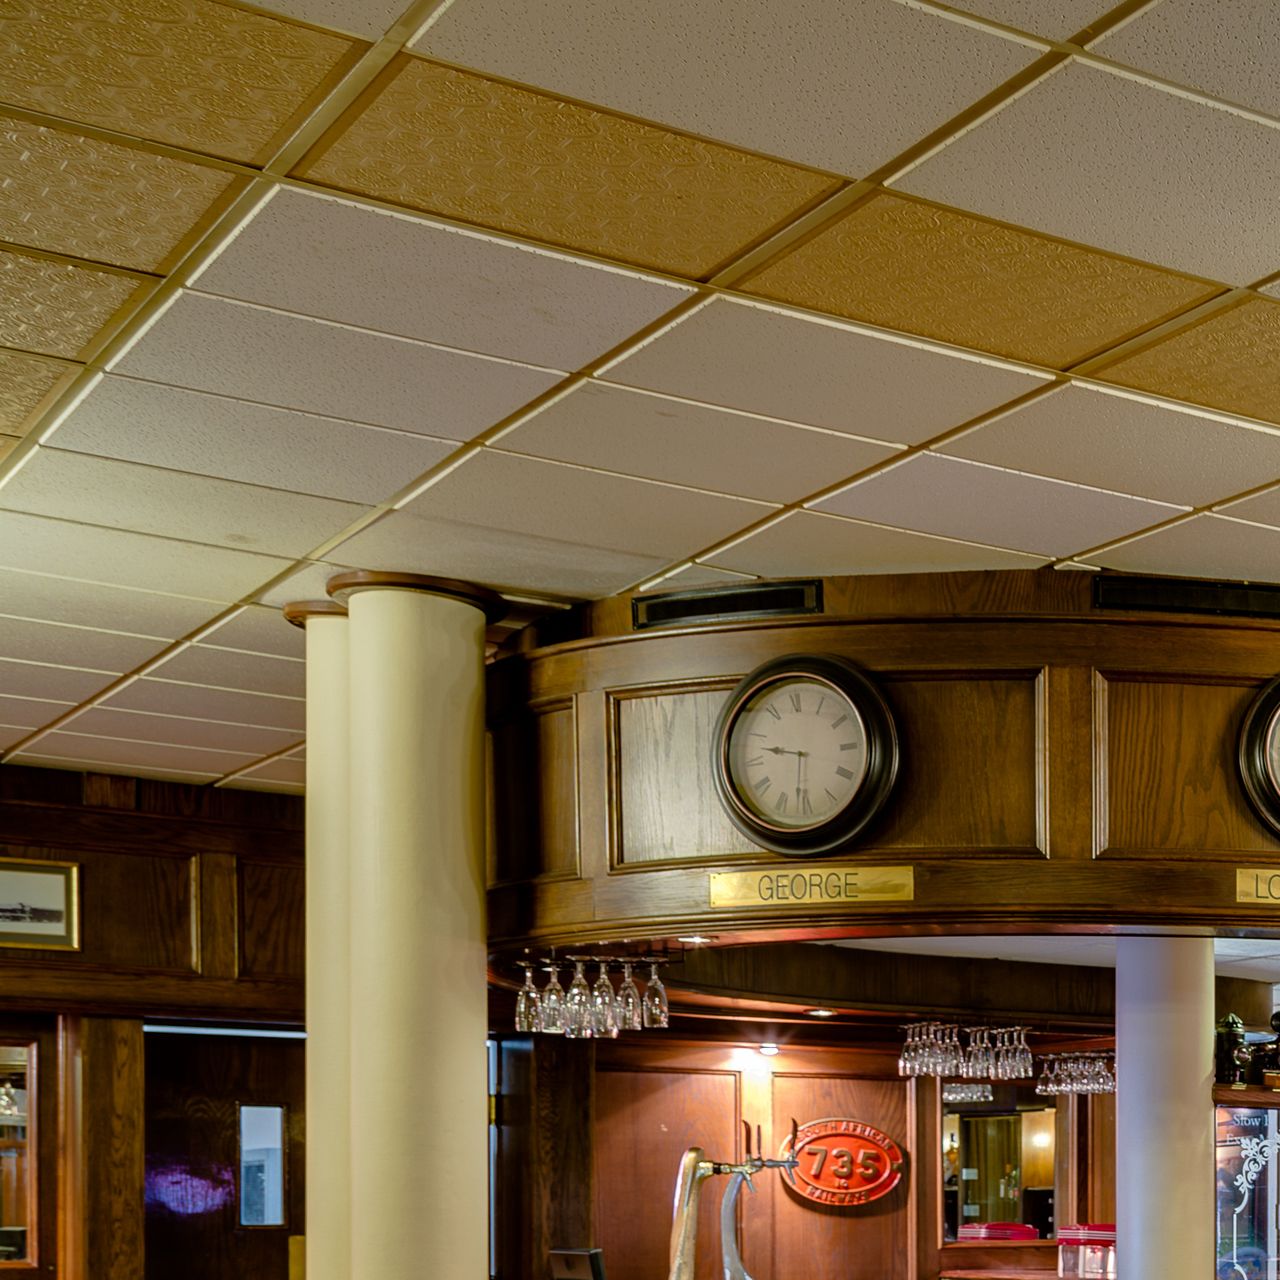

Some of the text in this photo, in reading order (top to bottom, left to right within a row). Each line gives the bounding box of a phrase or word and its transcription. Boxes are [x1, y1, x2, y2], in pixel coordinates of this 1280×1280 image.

[758, 872, 859, 900] GEORGE
[841, 1120, 893, 1150] AFRICAN
[804, 1145, 878, 1178] 735
[805, 1184, 868, 1202] RAILWAYS
